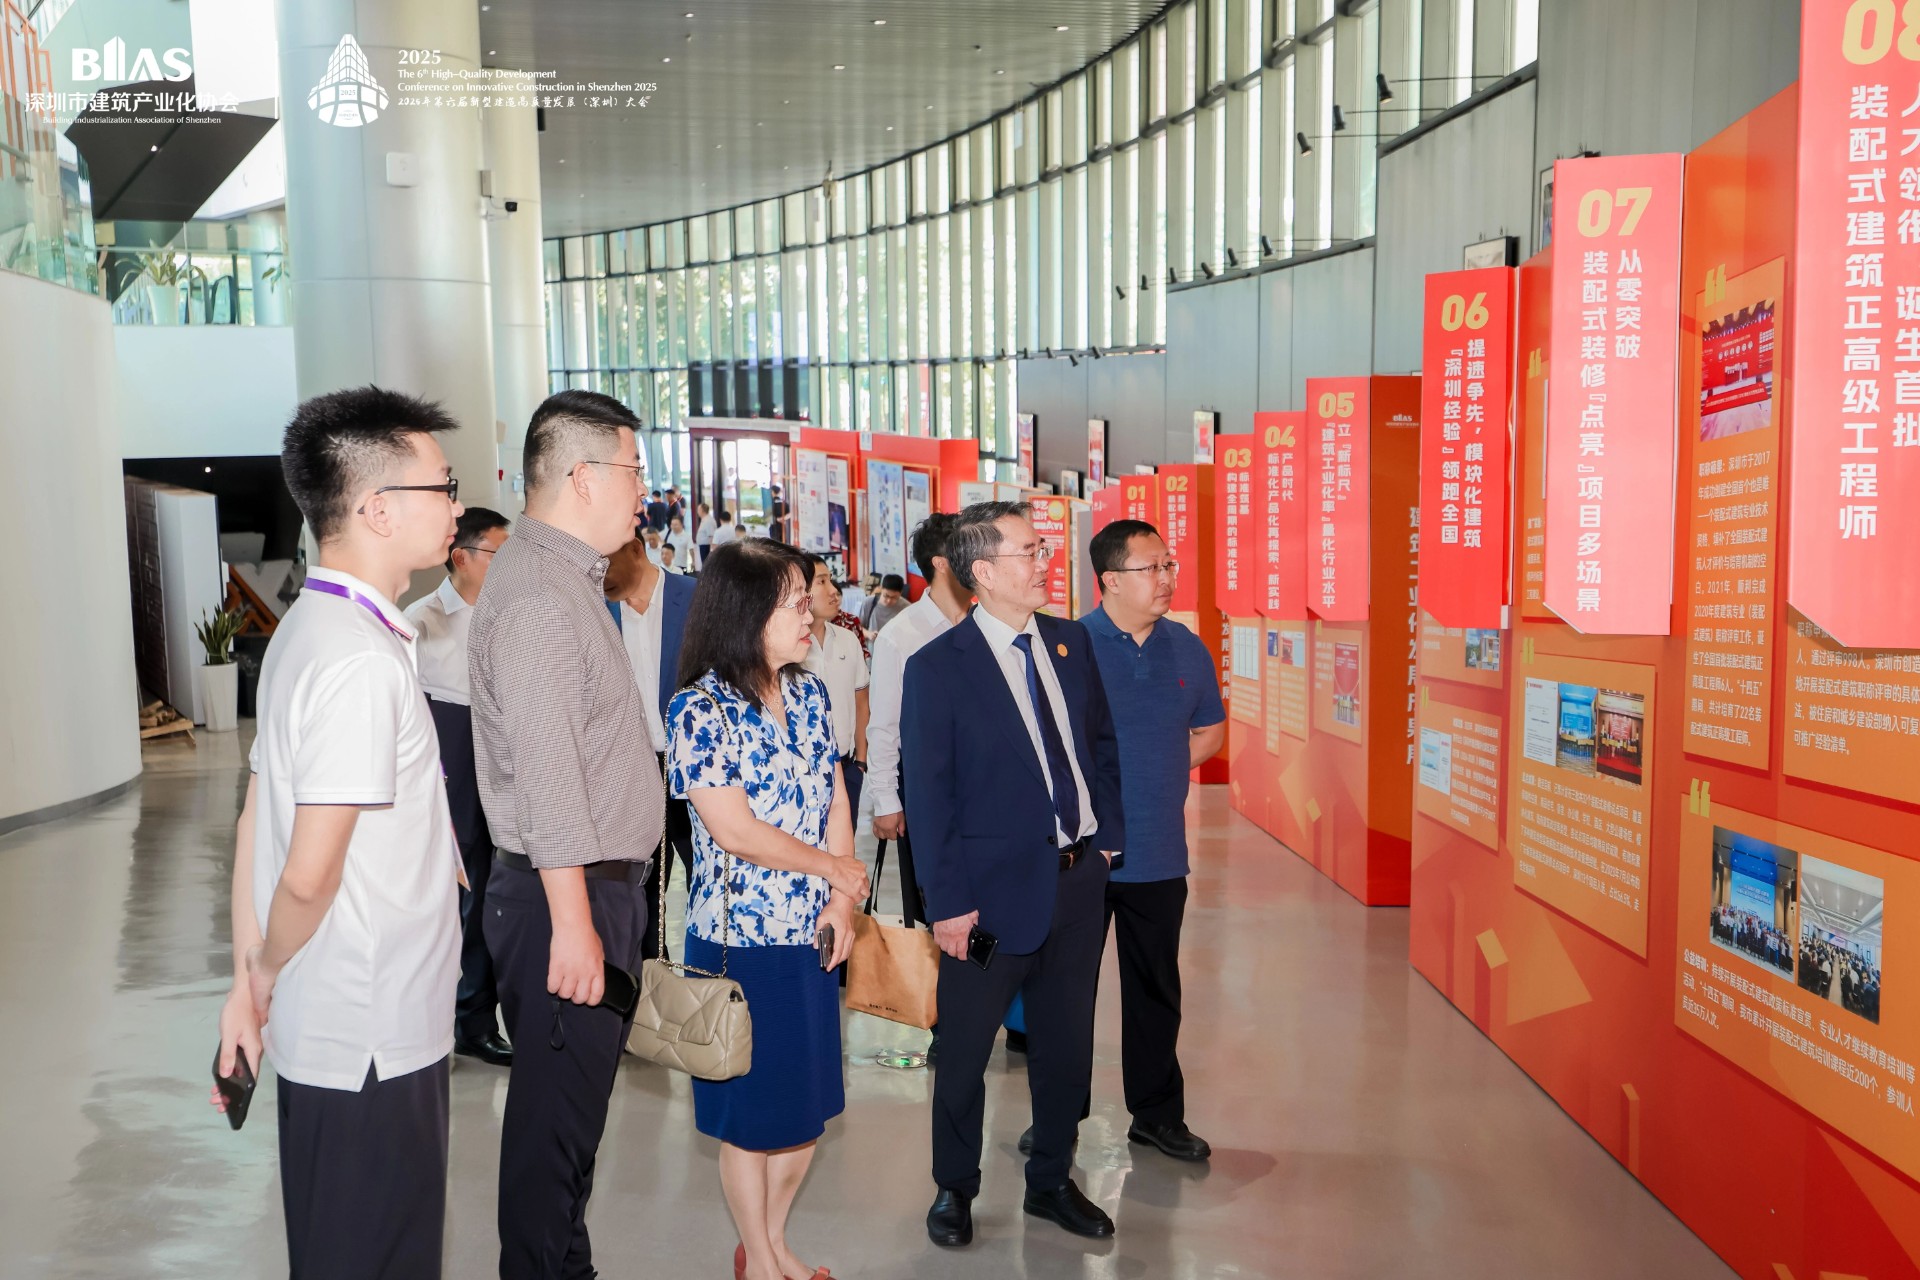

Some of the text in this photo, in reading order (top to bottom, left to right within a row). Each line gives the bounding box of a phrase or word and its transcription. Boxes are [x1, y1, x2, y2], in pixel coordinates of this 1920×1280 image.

[1577, 186, 1653, 238] 07
[1441, 292, 1490, 332] 06
[1614, 248, 1643, 359] 从零突破
[1838, 84, 1888, 540] 装配式建筑正高级工程师
[1318, 391, 1355, 419] 05
[1264, 425, 1296, 448] 04
[1224, 447, 1252, 469] 03
[1127, 485, 1146, 501] 01
[1165, 475, 1189, 493] 02
[1281, 452, 1294, 502] 产品时代
